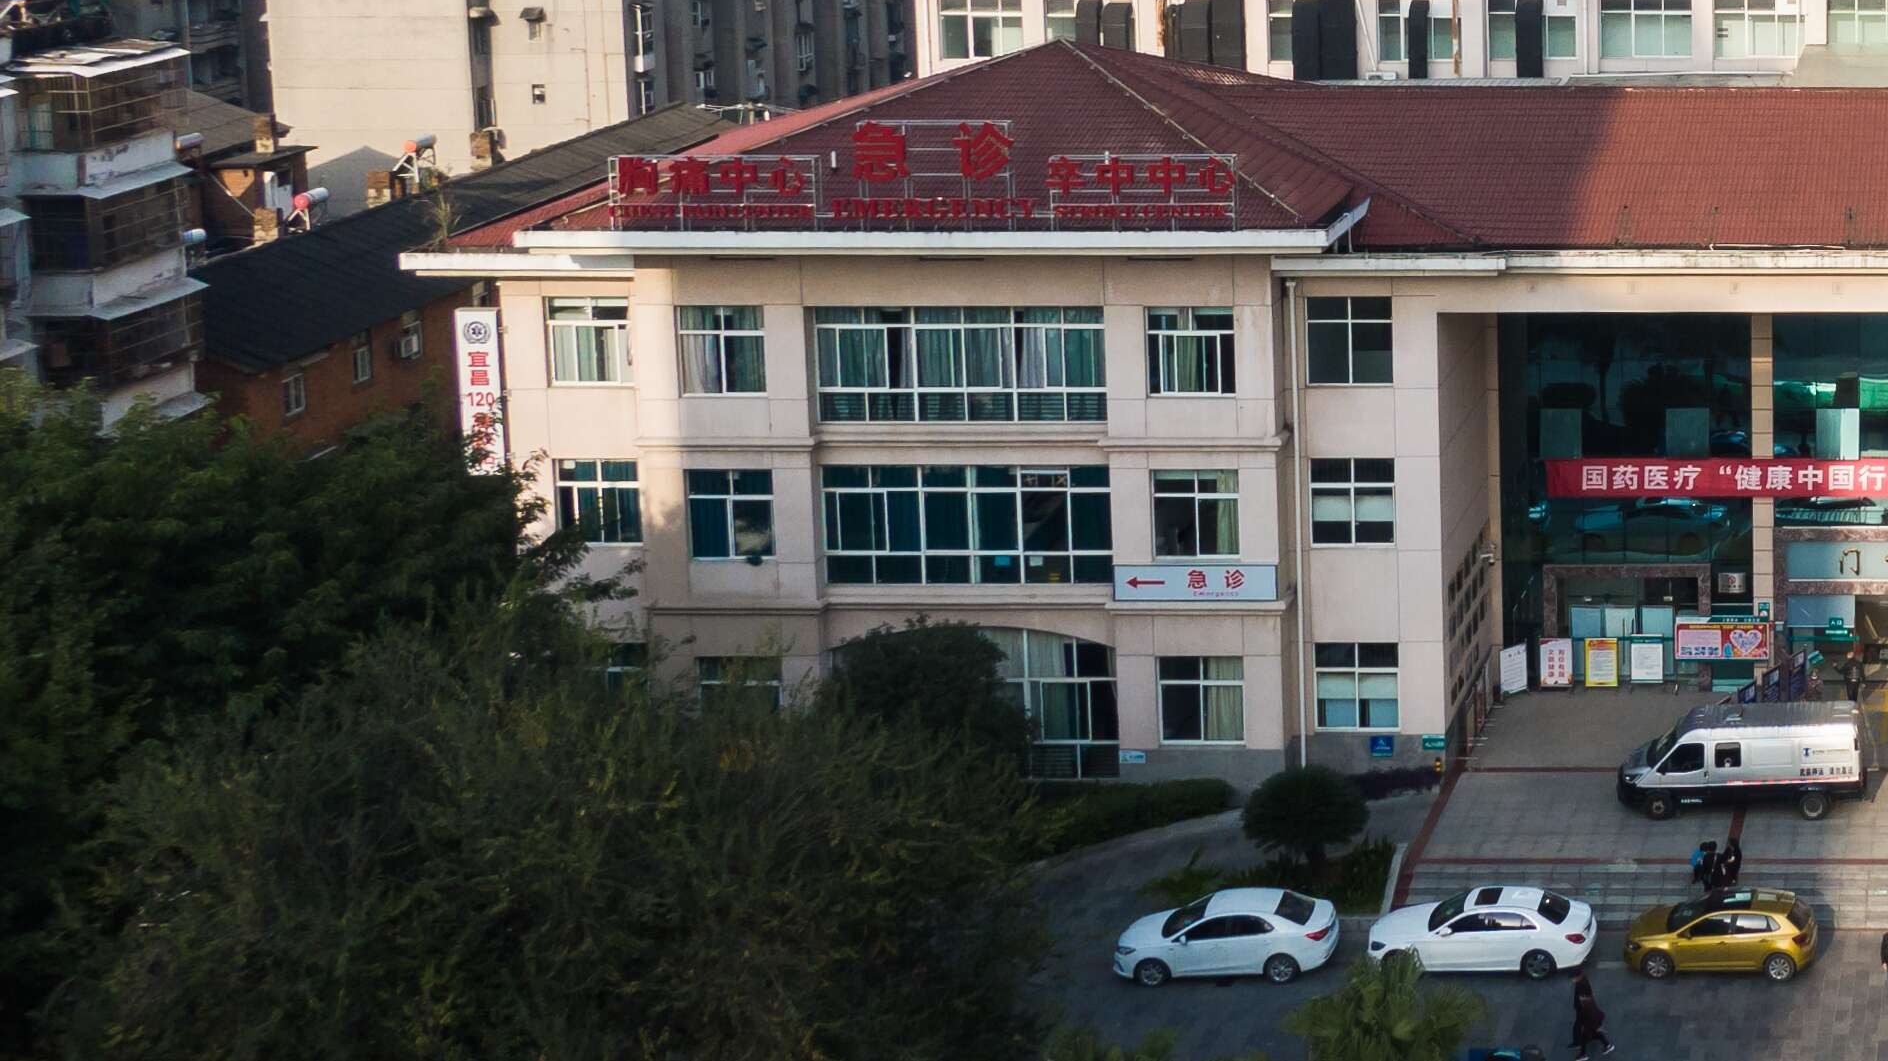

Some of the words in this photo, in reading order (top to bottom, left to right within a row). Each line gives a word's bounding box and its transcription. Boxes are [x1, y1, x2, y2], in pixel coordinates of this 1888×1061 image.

[852, 122, 1015, 181] 急诊
[618, 156, 806, 197] 胸痛中心
[1045, 156, 1236, 197] 卒中中心
[832, 197, 1040, 220] EMERGENCY
[1187, 569, 1245, 590] 急诊
